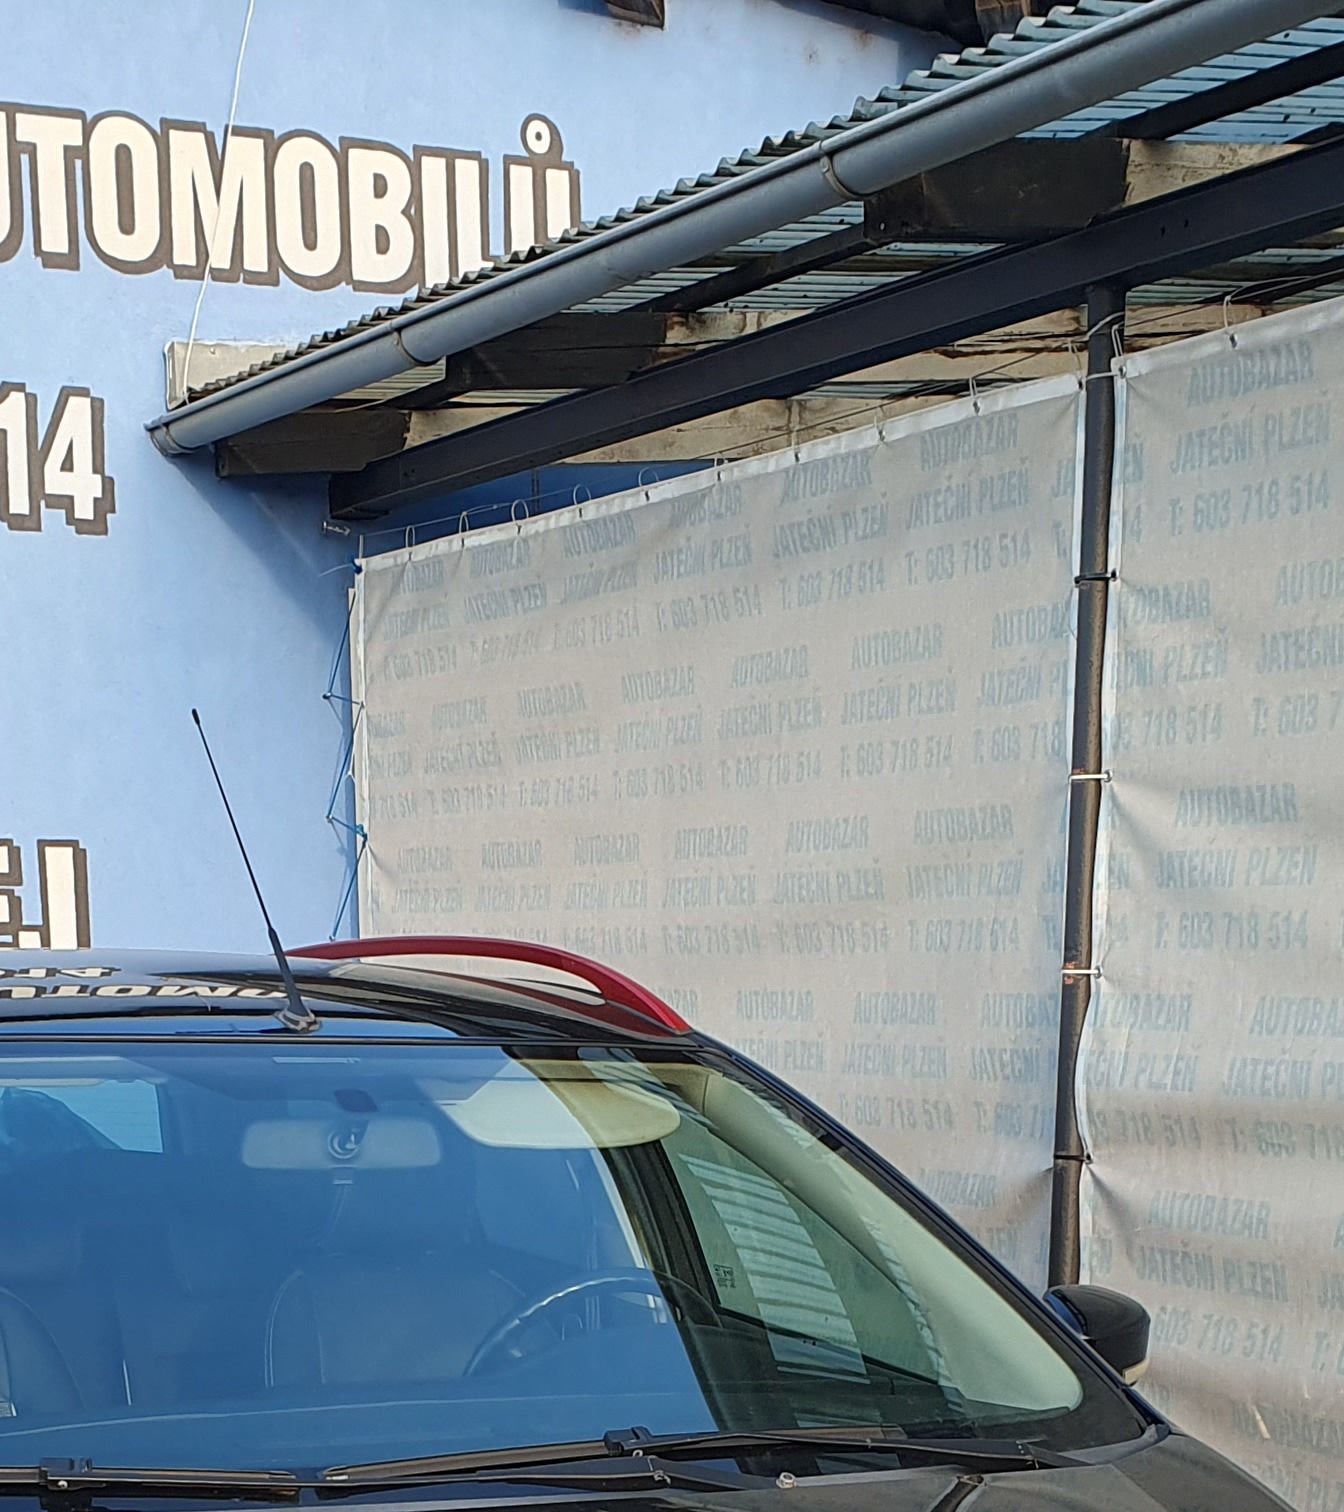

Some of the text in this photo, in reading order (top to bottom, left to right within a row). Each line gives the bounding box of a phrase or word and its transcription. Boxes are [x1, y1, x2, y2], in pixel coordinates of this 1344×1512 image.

[1186, 338, 1314, 407] AUTOBAZAR
[1263, 389, 1330, 455] PLZEŇ
[1193, 488, 1231, 533] 603
[1241, 478, 1280, 524] 718
[1288, 469, 1329, 516] 514
[1174, 782, 1298, 827] AUTOBAZAR
[1149, 1189, 1269, 1240] AUTOBAZAR
[1223, 1253, 1287, 1303] PLZEŇ
